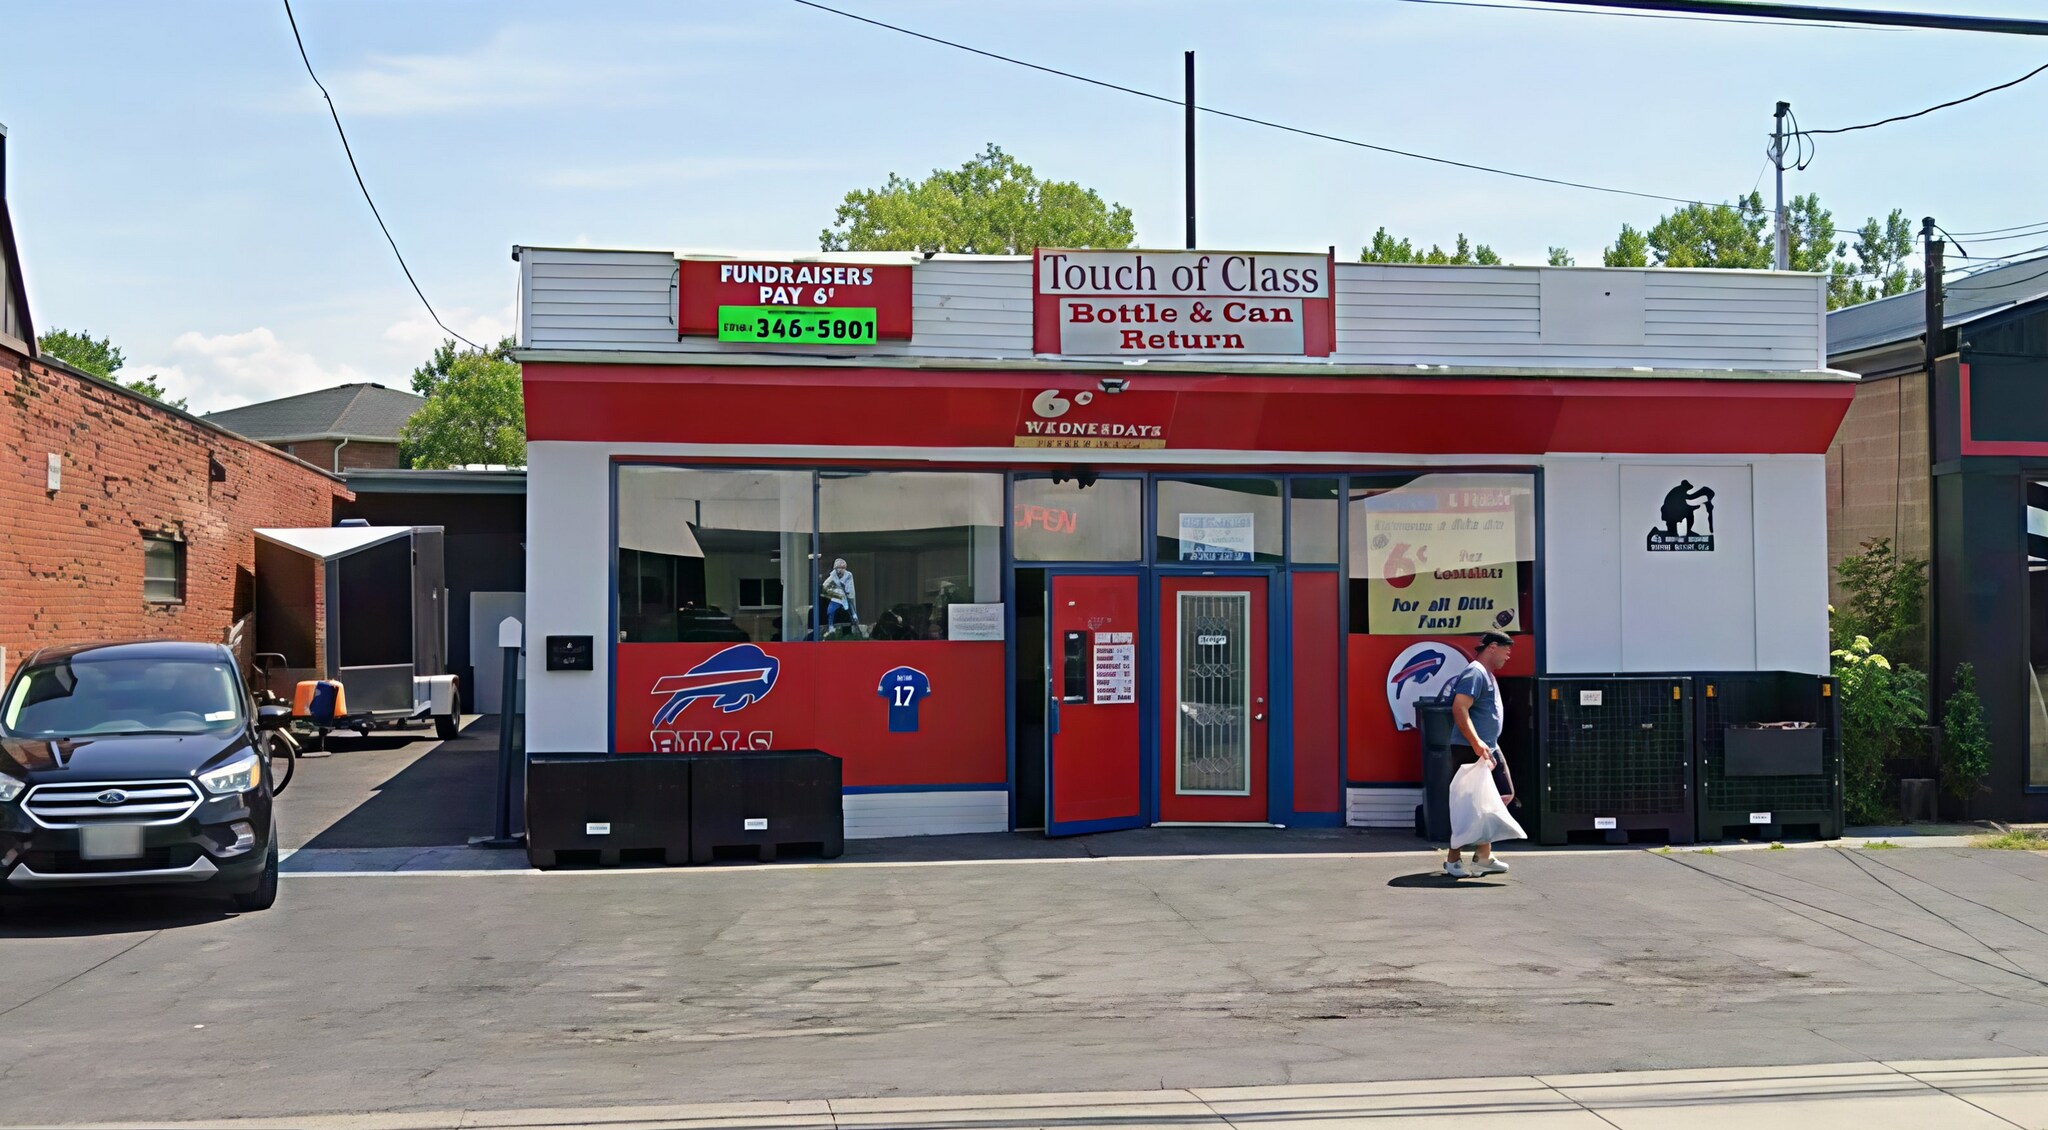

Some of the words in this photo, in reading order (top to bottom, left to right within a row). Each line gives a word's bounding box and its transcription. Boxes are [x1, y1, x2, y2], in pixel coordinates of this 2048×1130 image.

[720, 265, 874, 286] FUNDRAISERS
[1043, 255, 1157, 292] Touch
[1171, 256, 1210, 292] of
[1221, 256, 1319, 293] Class
[760, 286, 803, 305] PAY
[1068, 303, 1178, 324] Bottle
[1189, 301, 1213, 323] &
[1223, 302, 1294, 323] Can
[1120, 329, 1245, 350] Return
[894, 685, 915, 707] 17
